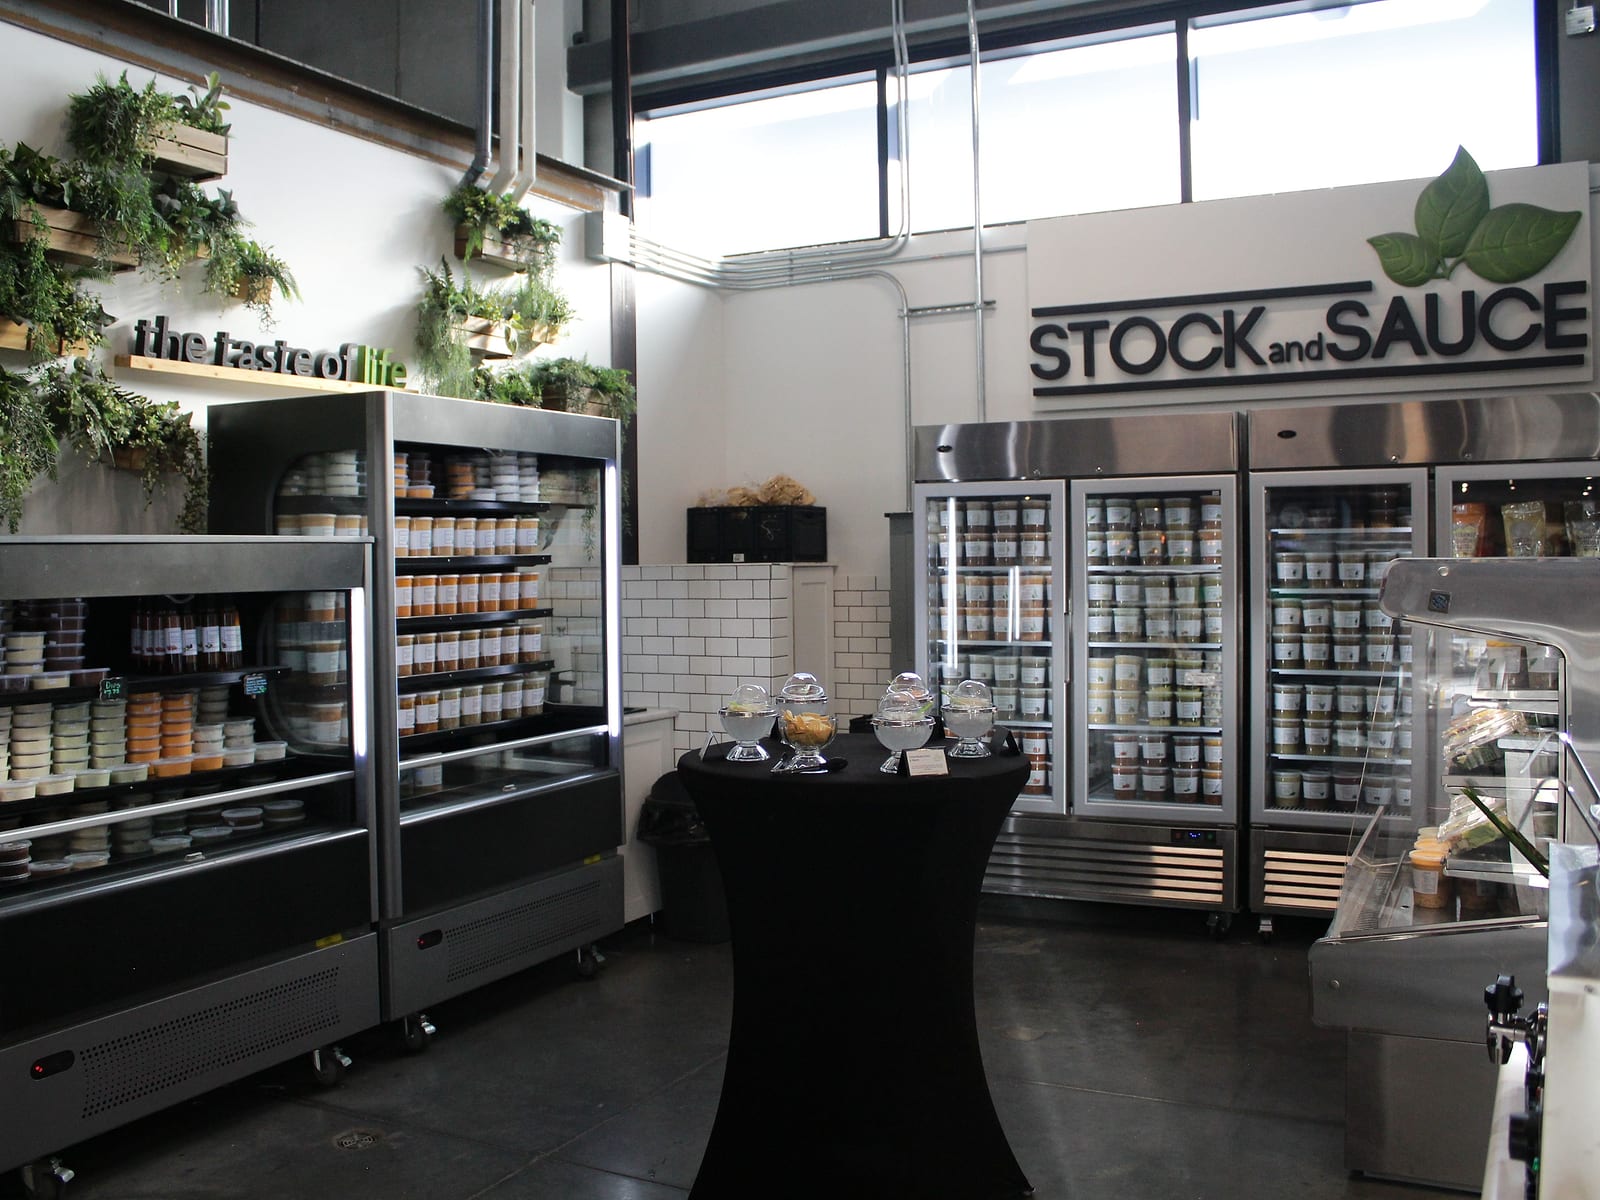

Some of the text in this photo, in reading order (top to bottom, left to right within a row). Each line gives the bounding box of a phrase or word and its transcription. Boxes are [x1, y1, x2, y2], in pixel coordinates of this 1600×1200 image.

[134, 315, 407, 389] the taste of life
[1030, 280, 1587, 380] STOCK and SAUCE
